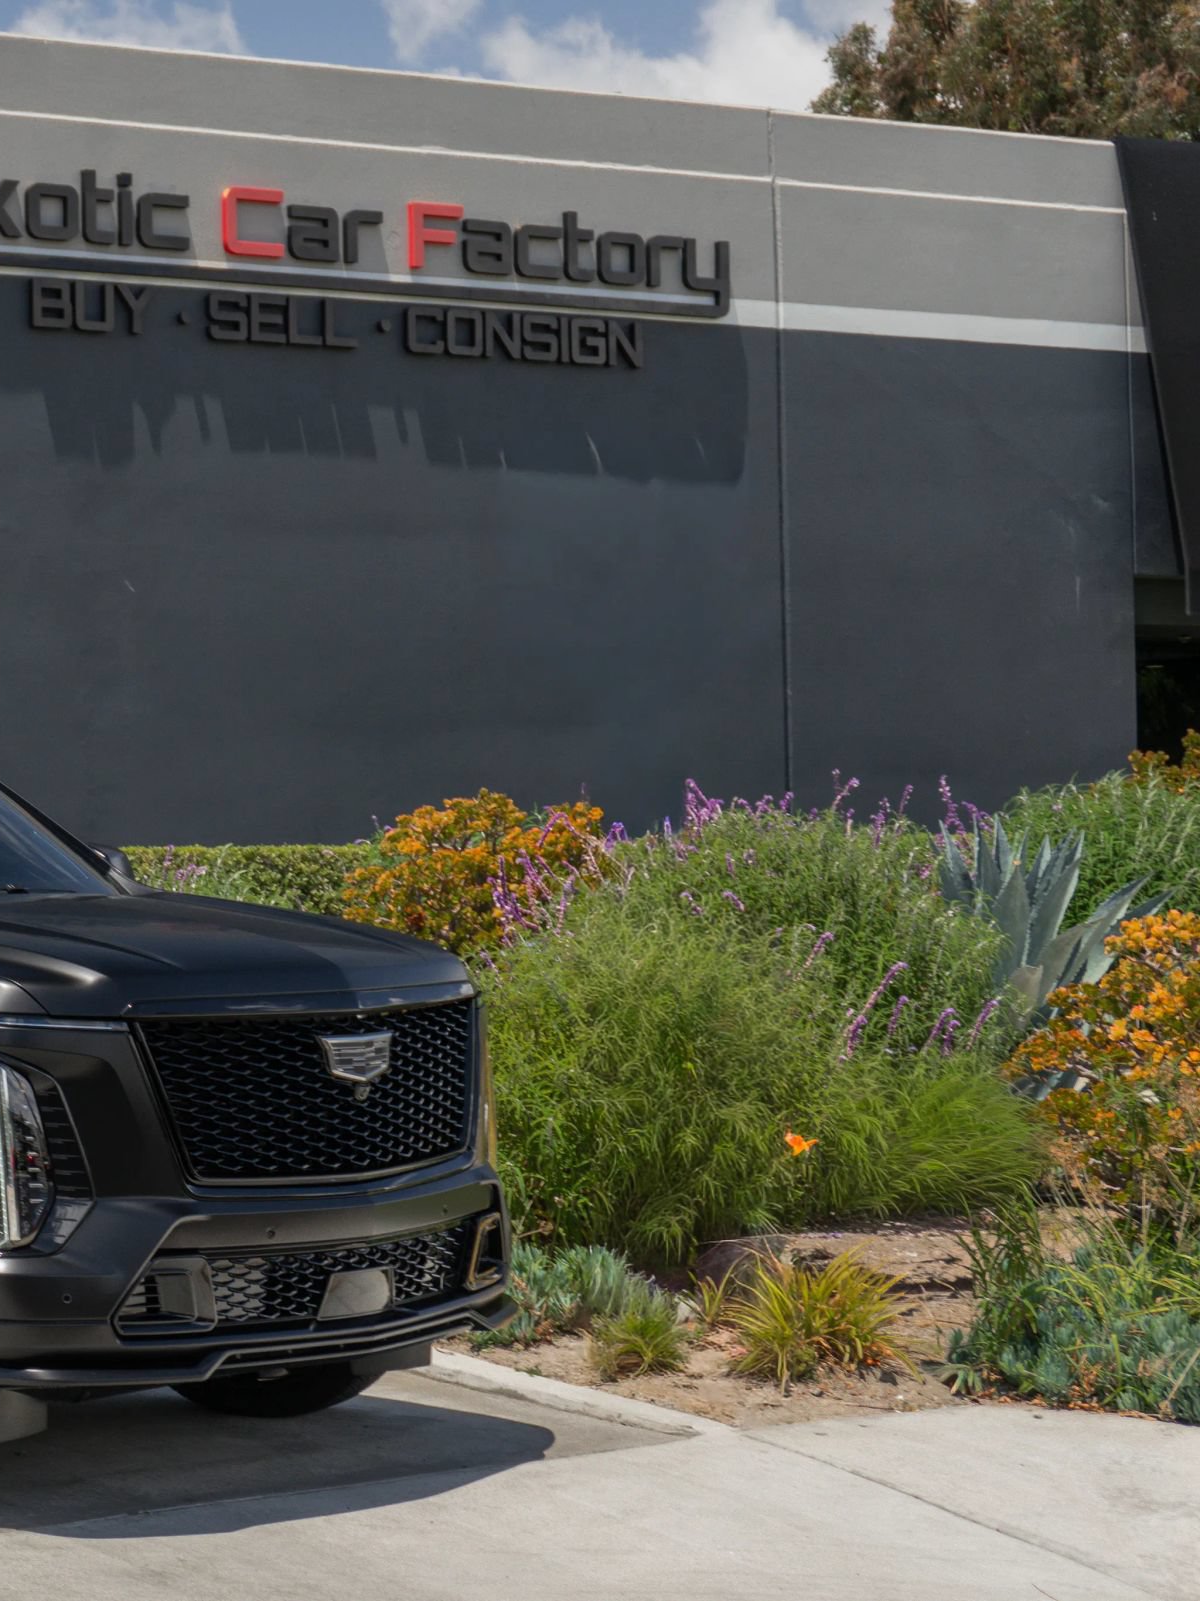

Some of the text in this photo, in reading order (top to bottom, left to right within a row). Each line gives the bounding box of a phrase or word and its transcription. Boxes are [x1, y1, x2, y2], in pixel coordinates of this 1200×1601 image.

[221, 186, 383, 264] Car
[407, 201, 731, 318] Factory
[31, 276, 644, 369] BUY SELL CONSIGN
